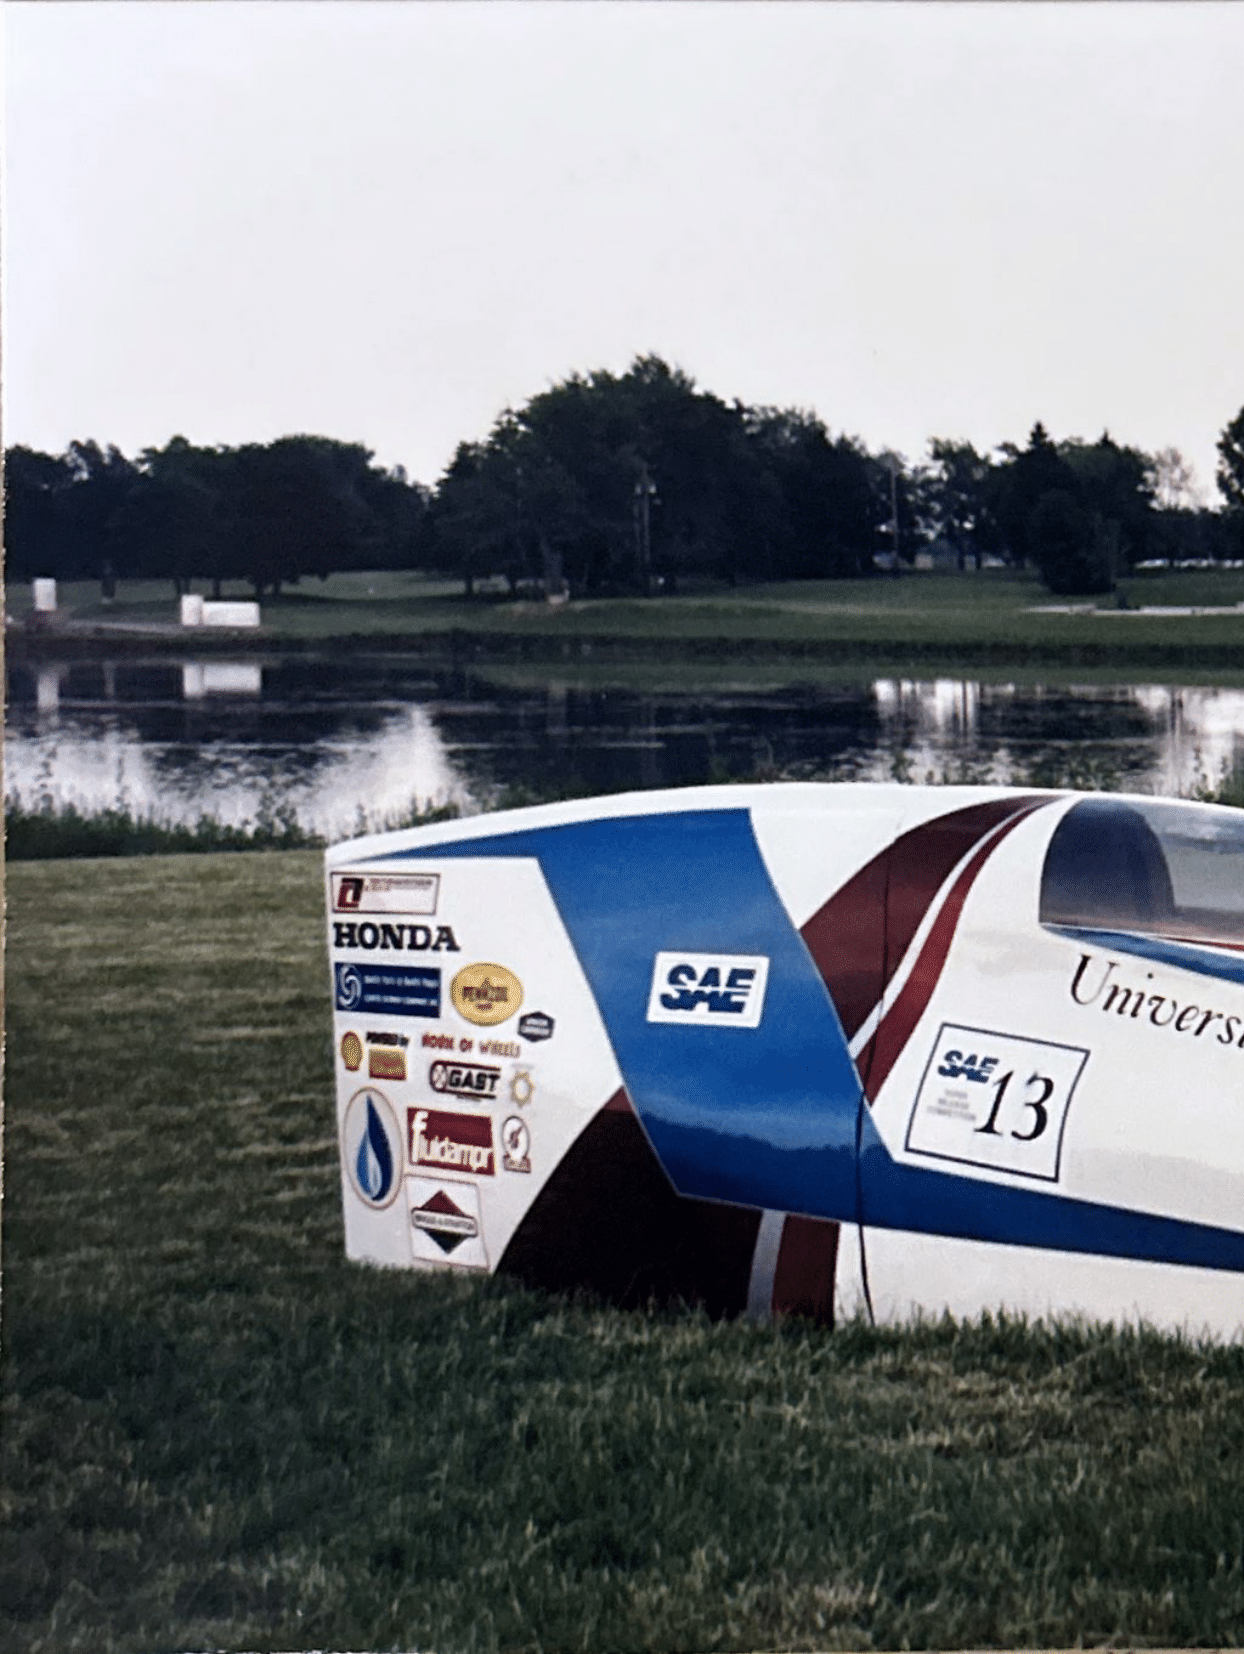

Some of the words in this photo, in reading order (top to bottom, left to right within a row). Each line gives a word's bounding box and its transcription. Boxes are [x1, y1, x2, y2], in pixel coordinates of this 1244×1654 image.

[333, 922, 461, 952] HONDA
[660, 964, 757, 1013] SAE
[448, 1069, 501, 1092] GAST
[937, 1050, 999, 1084] SAE
[973, 1070, 1054, 1141] 13
